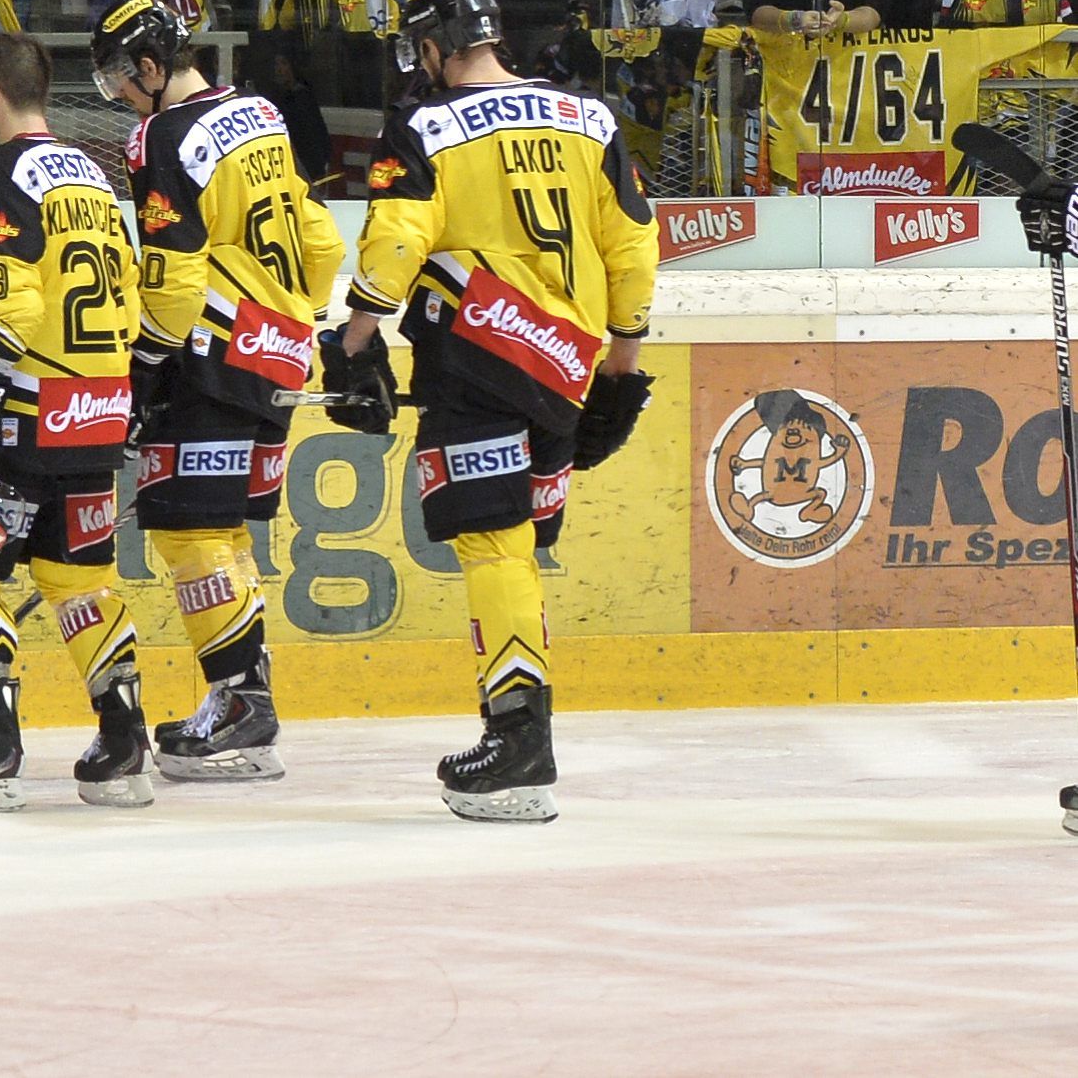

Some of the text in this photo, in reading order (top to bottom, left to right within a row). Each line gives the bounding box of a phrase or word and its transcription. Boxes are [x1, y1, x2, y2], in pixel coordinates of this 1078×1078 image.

[461, 94, 551, 132] ERSTE
[798, 49, 947, 146] 4/64
[213, 106, 267, 147] ERSTE
[39, 152, 96, 181] ERSTE
[803, 163, 934, 196] Almdudler
[512, 187, 576, 302] 4
[667, 206, 744, 245] Kelly's
[886, 206, 965, 245] Kelly's
[1050, 257, 1072, 377] SUPREME
[463, 298, 587, 382] Almdudler
[182, 448, 248, 471] ERSTE
[450, 444, 523, 476] ERSTE
[773, 457, 812, 483] M
[764, 538, 790, 554] Dein
[792, 538, 817, 554] Rohr
[885, 533, 952, 564] Ihr
